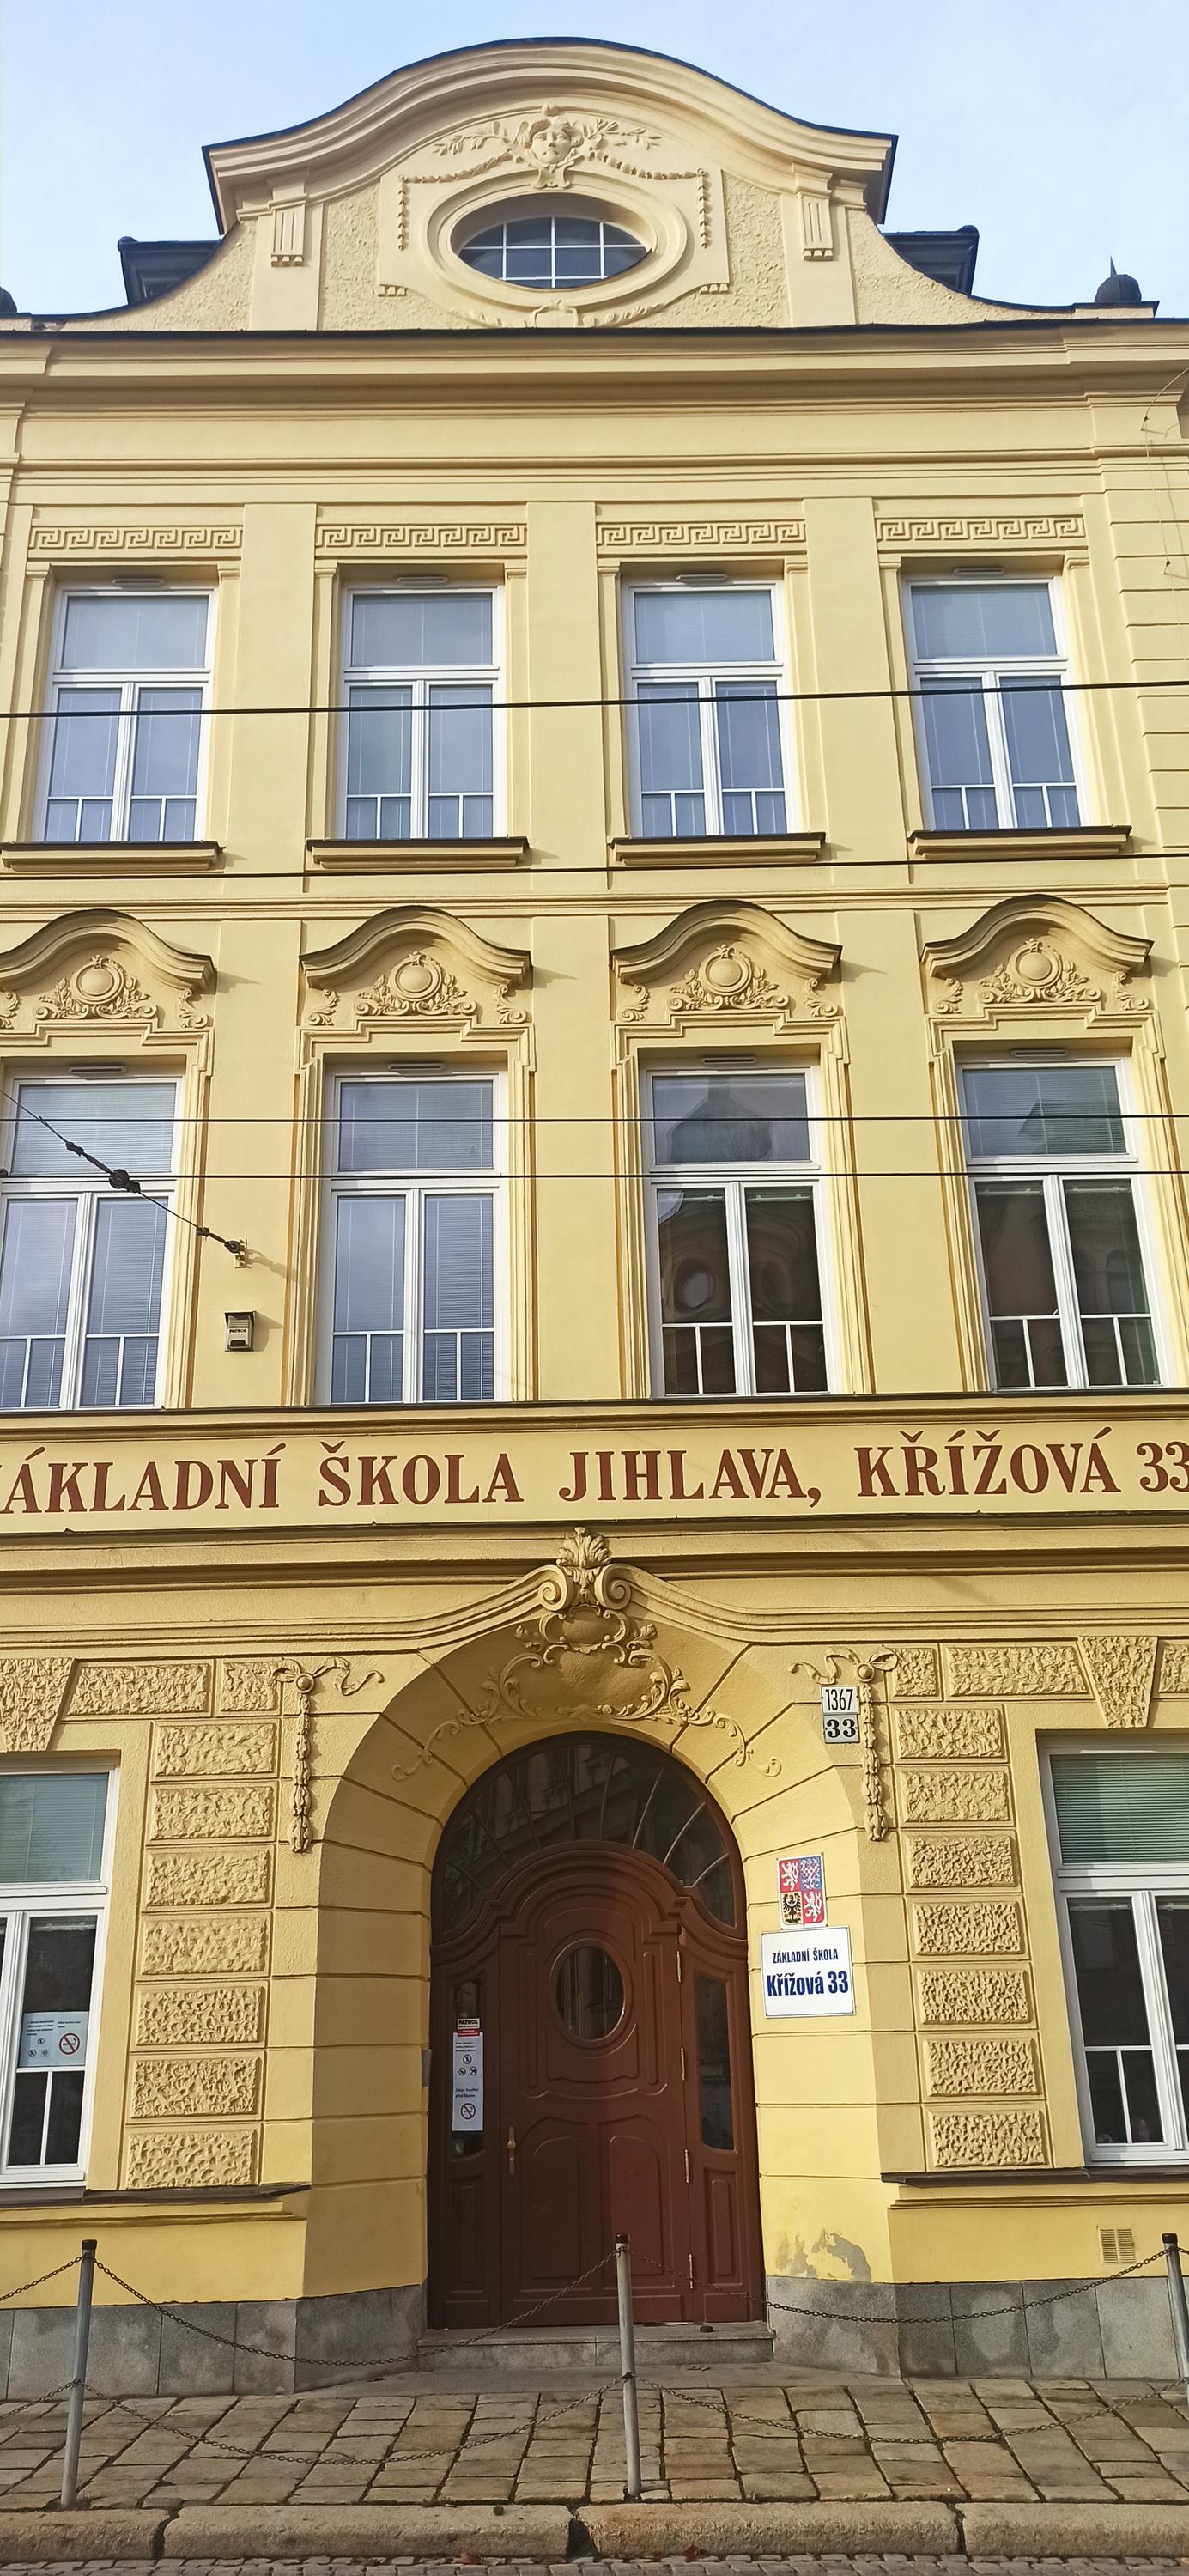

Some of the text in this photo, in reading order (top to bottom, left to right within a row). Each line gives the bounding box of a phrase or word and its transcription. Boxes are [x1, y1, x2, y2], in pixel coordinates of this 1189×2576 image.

[0, 1426, 1189, 1514] ÁKLADNÍ ŠKOLA JIHLAVA, KŘÍŽOVÁ 33
[825, 1688, 853, 1711] 1367
[826, 1719, 856, 1739] 33
[772, 1947, 839, 1964] ZÁKLADNÍ ŠKOLA
[767, 1970, 849, 1996] Křížová 33
